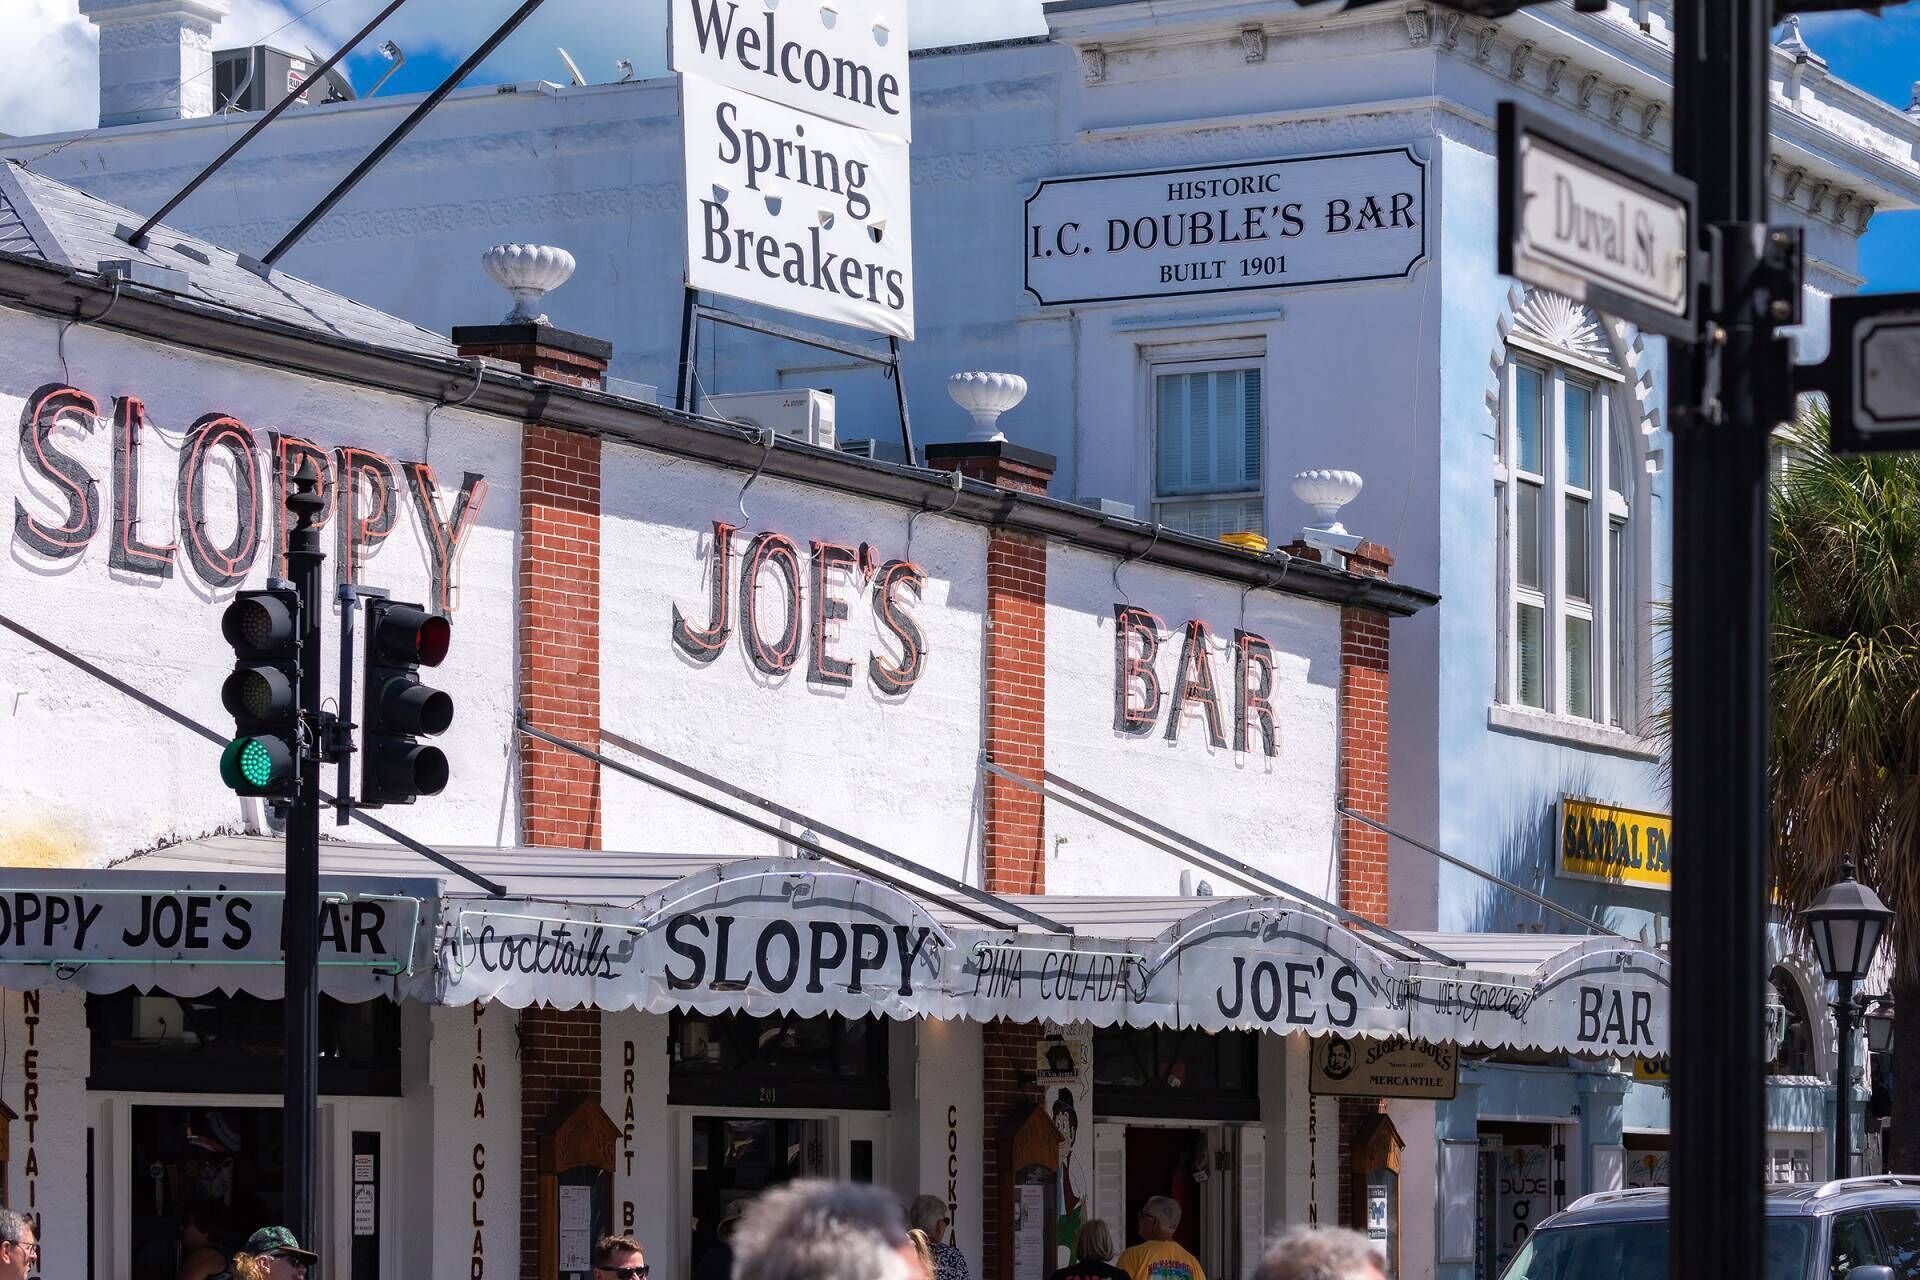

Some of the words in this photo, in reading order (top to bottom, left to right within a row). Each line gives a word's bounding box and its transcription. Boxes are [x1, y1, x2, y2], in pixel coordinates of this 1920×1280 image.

[690, 0, 900, 116] Welcome
[715, 101, 871, 220] Spring
[1167, 173, 1281, 202] HISTORIC
[699, 198, 905, 310] Breakers
[1031, 221, 1091, 259] I.C.
[1106, 203, 1304, 255] DOUBLE'S
[1326, 192, 1420, 235] BAR
[1555, 172, 1626, 265] Duval
[1633, 207, 1655, 279] St
[1159, 260, 1226, 284] BUILT
[1239, 255, 1288, 278] 1901
[14, 382, 488, 625] SLOPPY
[672, 519, 929, 696] JOE'S
[1112, 602, 1281, 758] BAR
[1564, 813, 1643, 870] SANDAL
[122, 884, 253, 951] JOE'S
[280, 898, 387, 954] AR
[480, 919, 622, 980] Cocktails
[664, 913, 931, 997] SLOPPY
[1040, 949, 1148, 1005] COLADAS
[1216, 956, 1360, 1029] JOE'S
[1434, 981, 1464, 1016] JOE'S
[1576, 985, 1655, 1046] BAR
[622, 1040, 636, 1177] DRAFT
[1369, 1075, 1443, 1087] MERCANTILE
